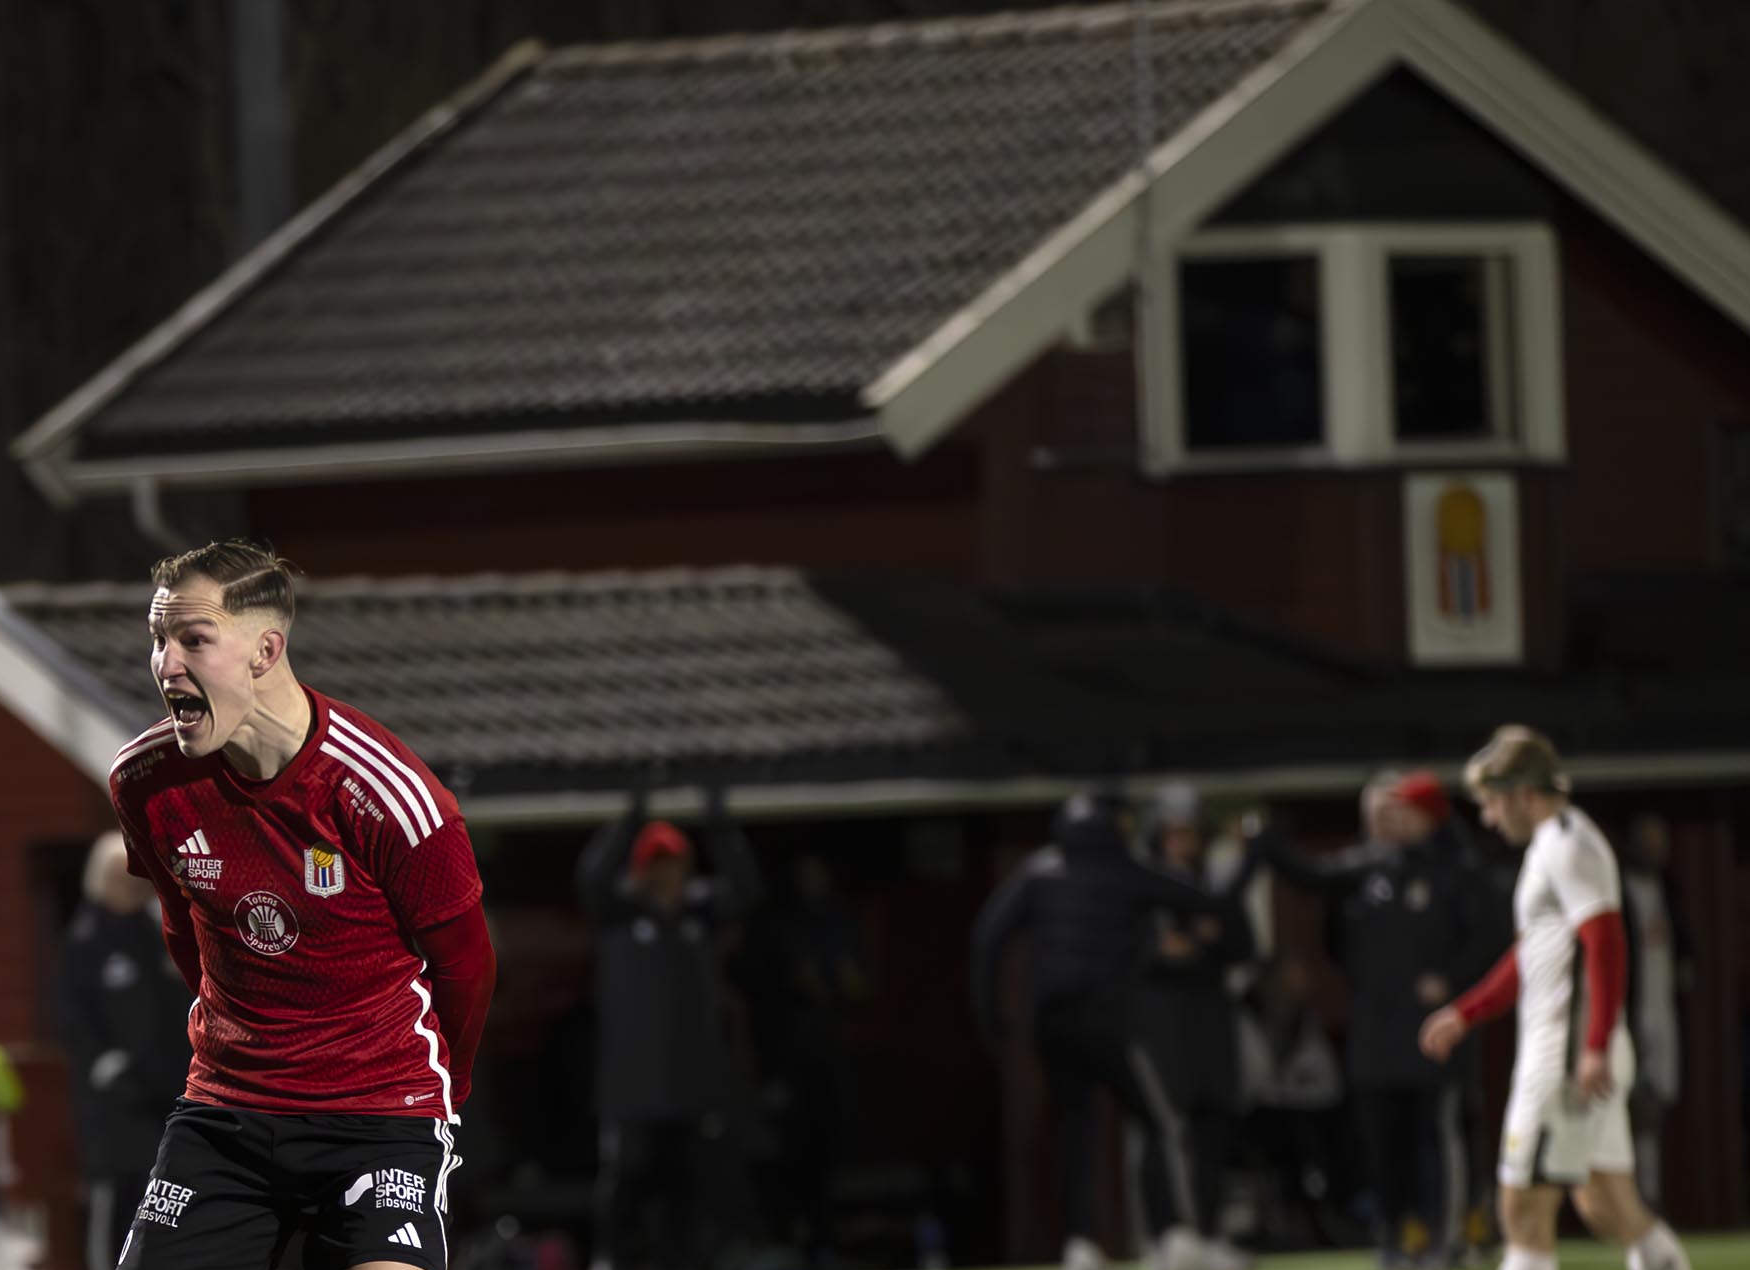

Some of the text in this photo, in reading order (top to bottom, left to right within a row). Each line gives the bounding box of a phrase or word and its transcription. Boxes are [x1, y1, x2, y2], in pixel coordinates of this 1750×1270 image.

[188, 857, 224, 869] INTER
[188, 868, 222, 880] SPORT
[375, 1168, 424, 1189] INTER
[375, 1182, 427, 1204] SPORT
[375, 1198, 425, 1215] EIDSVOLL
